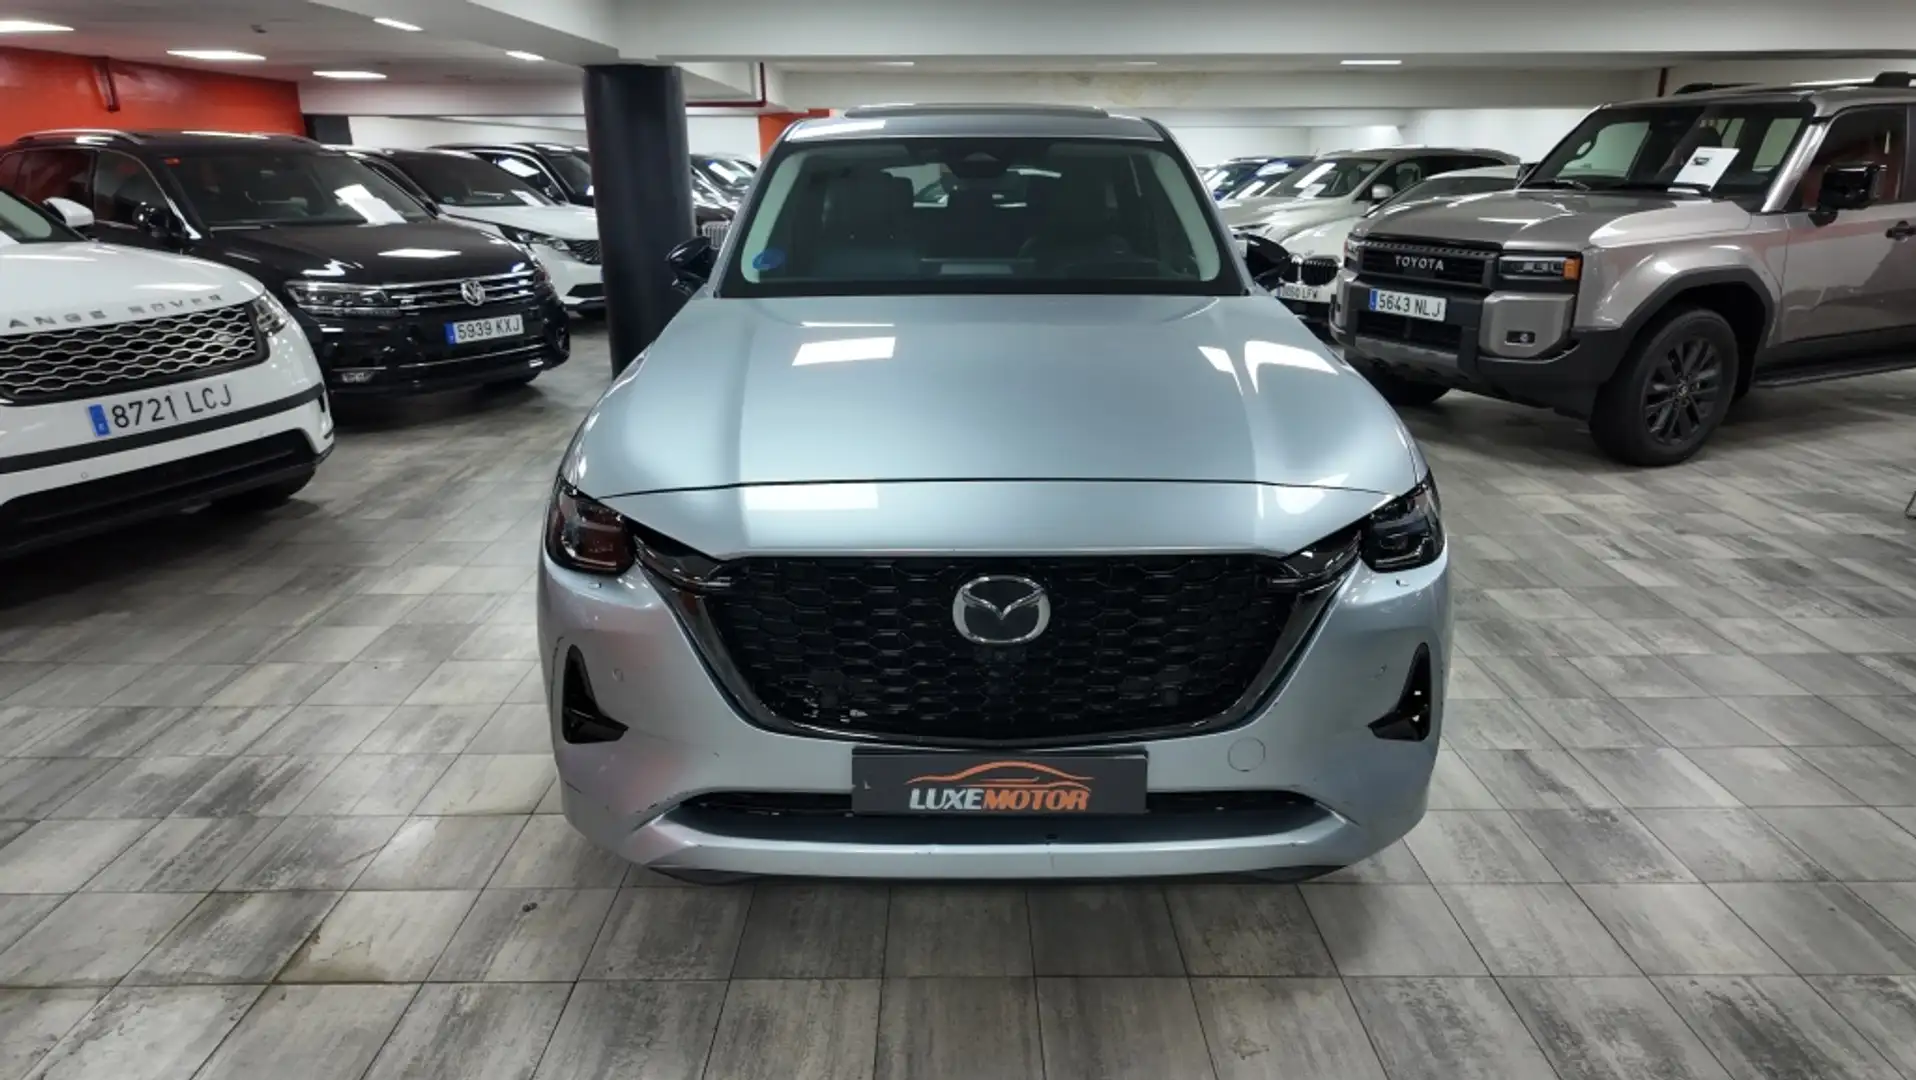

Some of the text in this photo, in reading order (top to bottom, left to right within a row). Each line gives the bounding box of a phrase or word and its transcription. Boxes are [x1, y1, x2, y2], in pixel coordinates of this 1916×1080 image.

[1395, 255, 1444, 271] TOYOTA
[1379, 293, 1441, 317] 5643 NLJ
[8, 310, 107, 329] ANGE
[457, 317, 520, 340] 5939 KXJ
[111, 383, 232, 428] 8721 LCJ
[909, 787, 1088, 810] LUXEMOTOR
